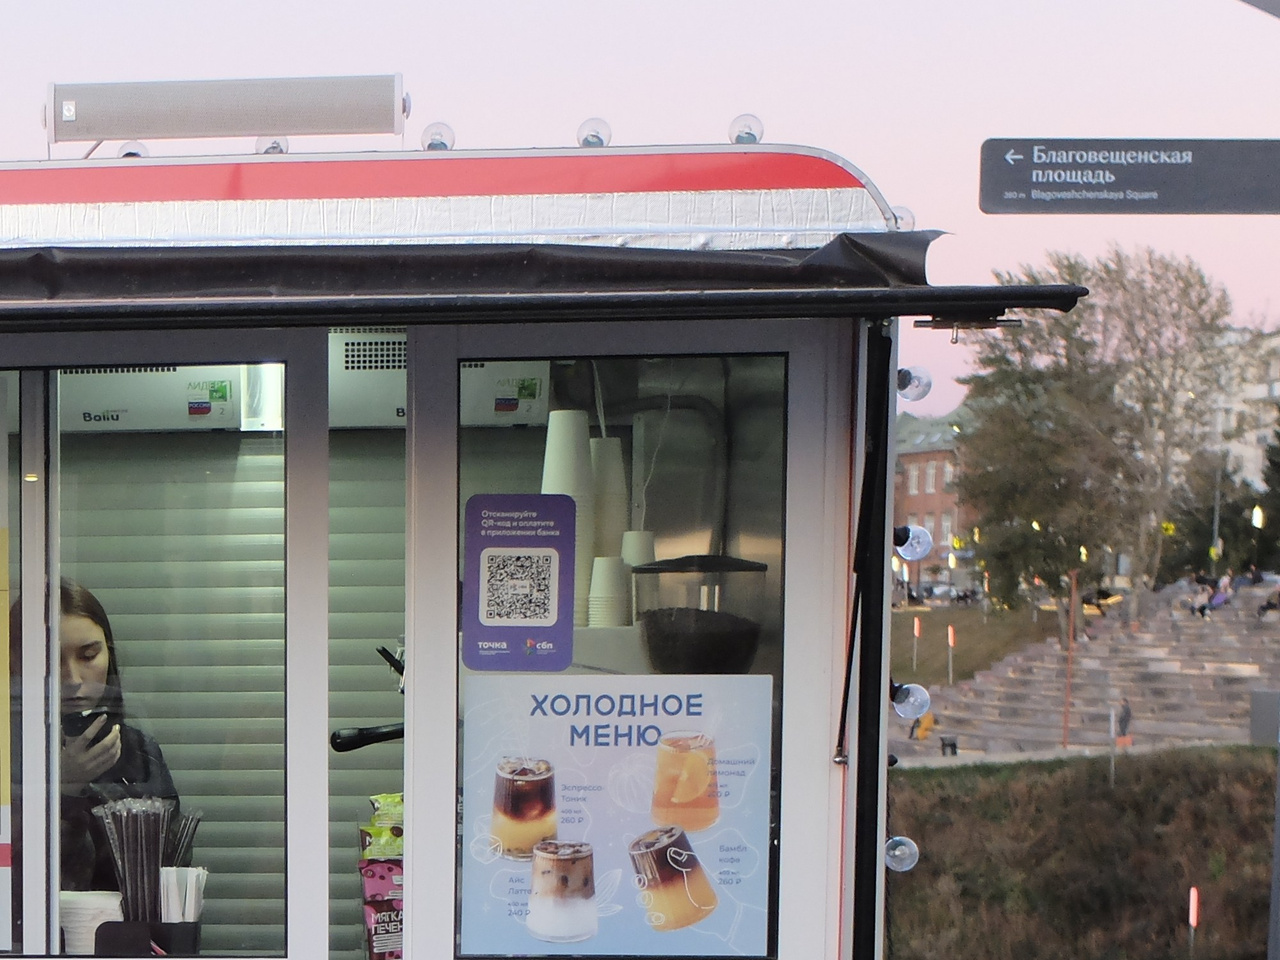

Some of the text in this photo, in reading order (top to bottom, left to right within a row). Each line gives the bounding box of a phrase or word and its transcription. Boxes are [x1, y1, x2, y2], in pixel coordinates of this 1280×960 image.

[1033, 146, 1192, 165] Благовещенская
[1032, 168, 1116, 183] площадь
[1031, 190, 1158, 201] Blagoveshchenskaya Square
[481, 510, 537, 519] Отсканируйте
[478, 641, 553, 649] точка сбп
[530, 694, 703, 717] ХОЛОДНОЕ
[570, 725, 662, 747] МЕНЮ
